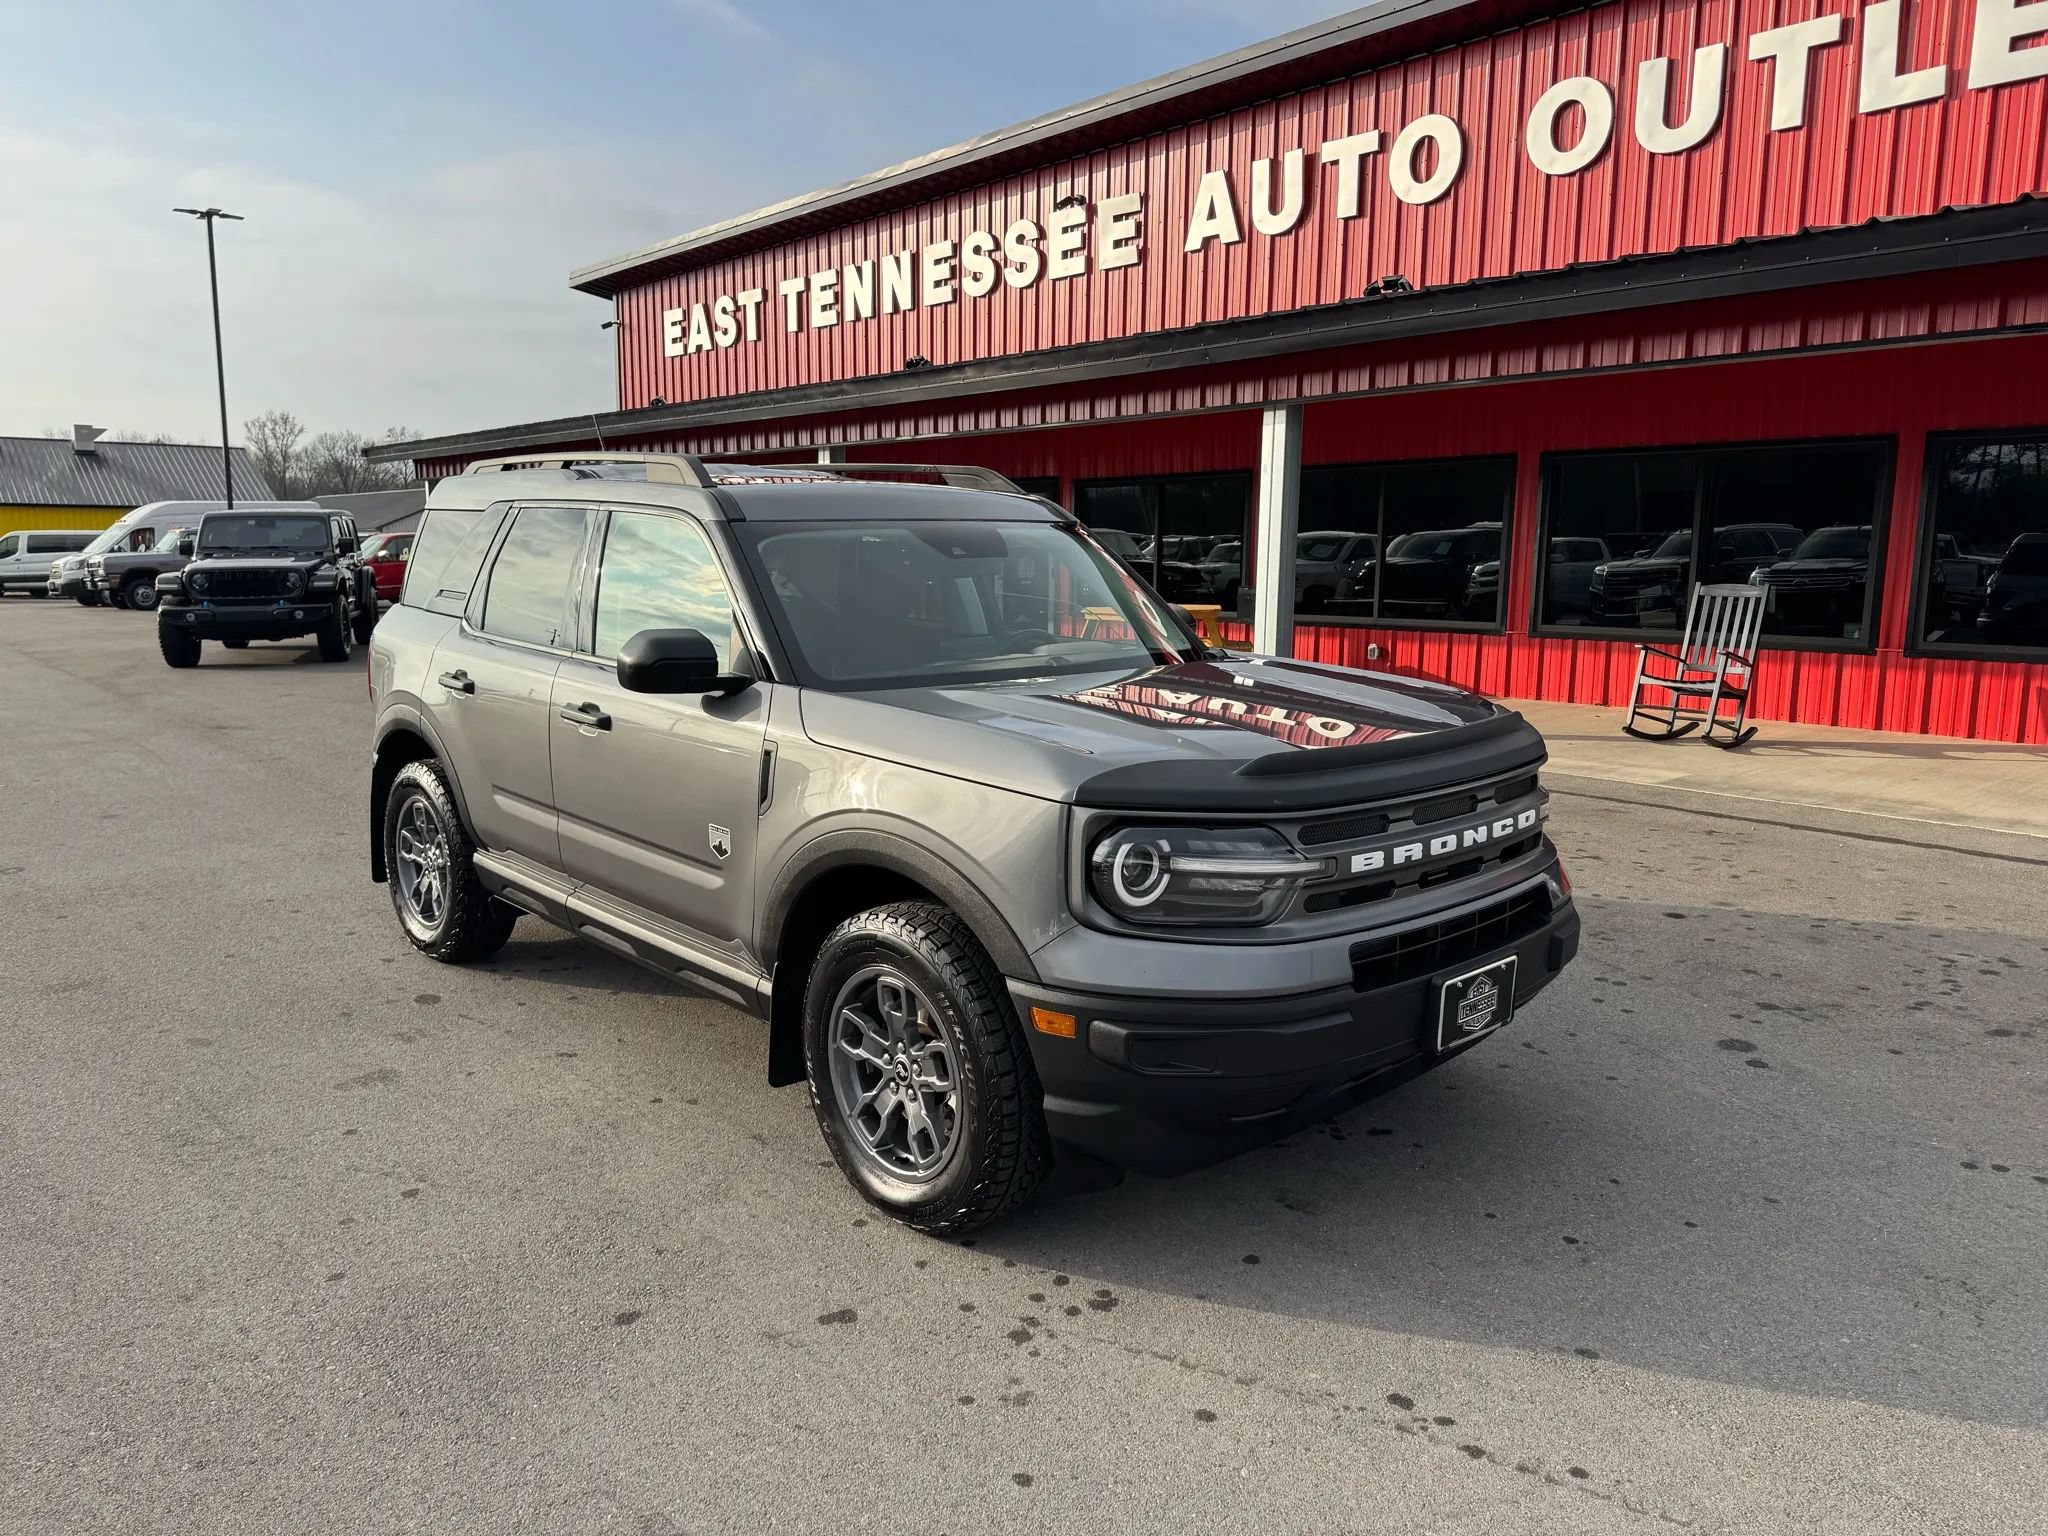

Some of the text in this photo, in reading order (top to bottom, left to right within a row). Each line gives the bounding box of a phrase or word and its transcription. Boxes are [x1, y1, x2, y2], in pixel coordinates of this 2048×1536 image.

[663, 287, 763, 358] EAST
[779, 192, 1143, 333] TENNESSEE
[1185, 113, 1463, 253] AUTO
[1351, 809, 1536, 873] BRONCO
[1461, 994, 1496, 1018] TENNESSEE
